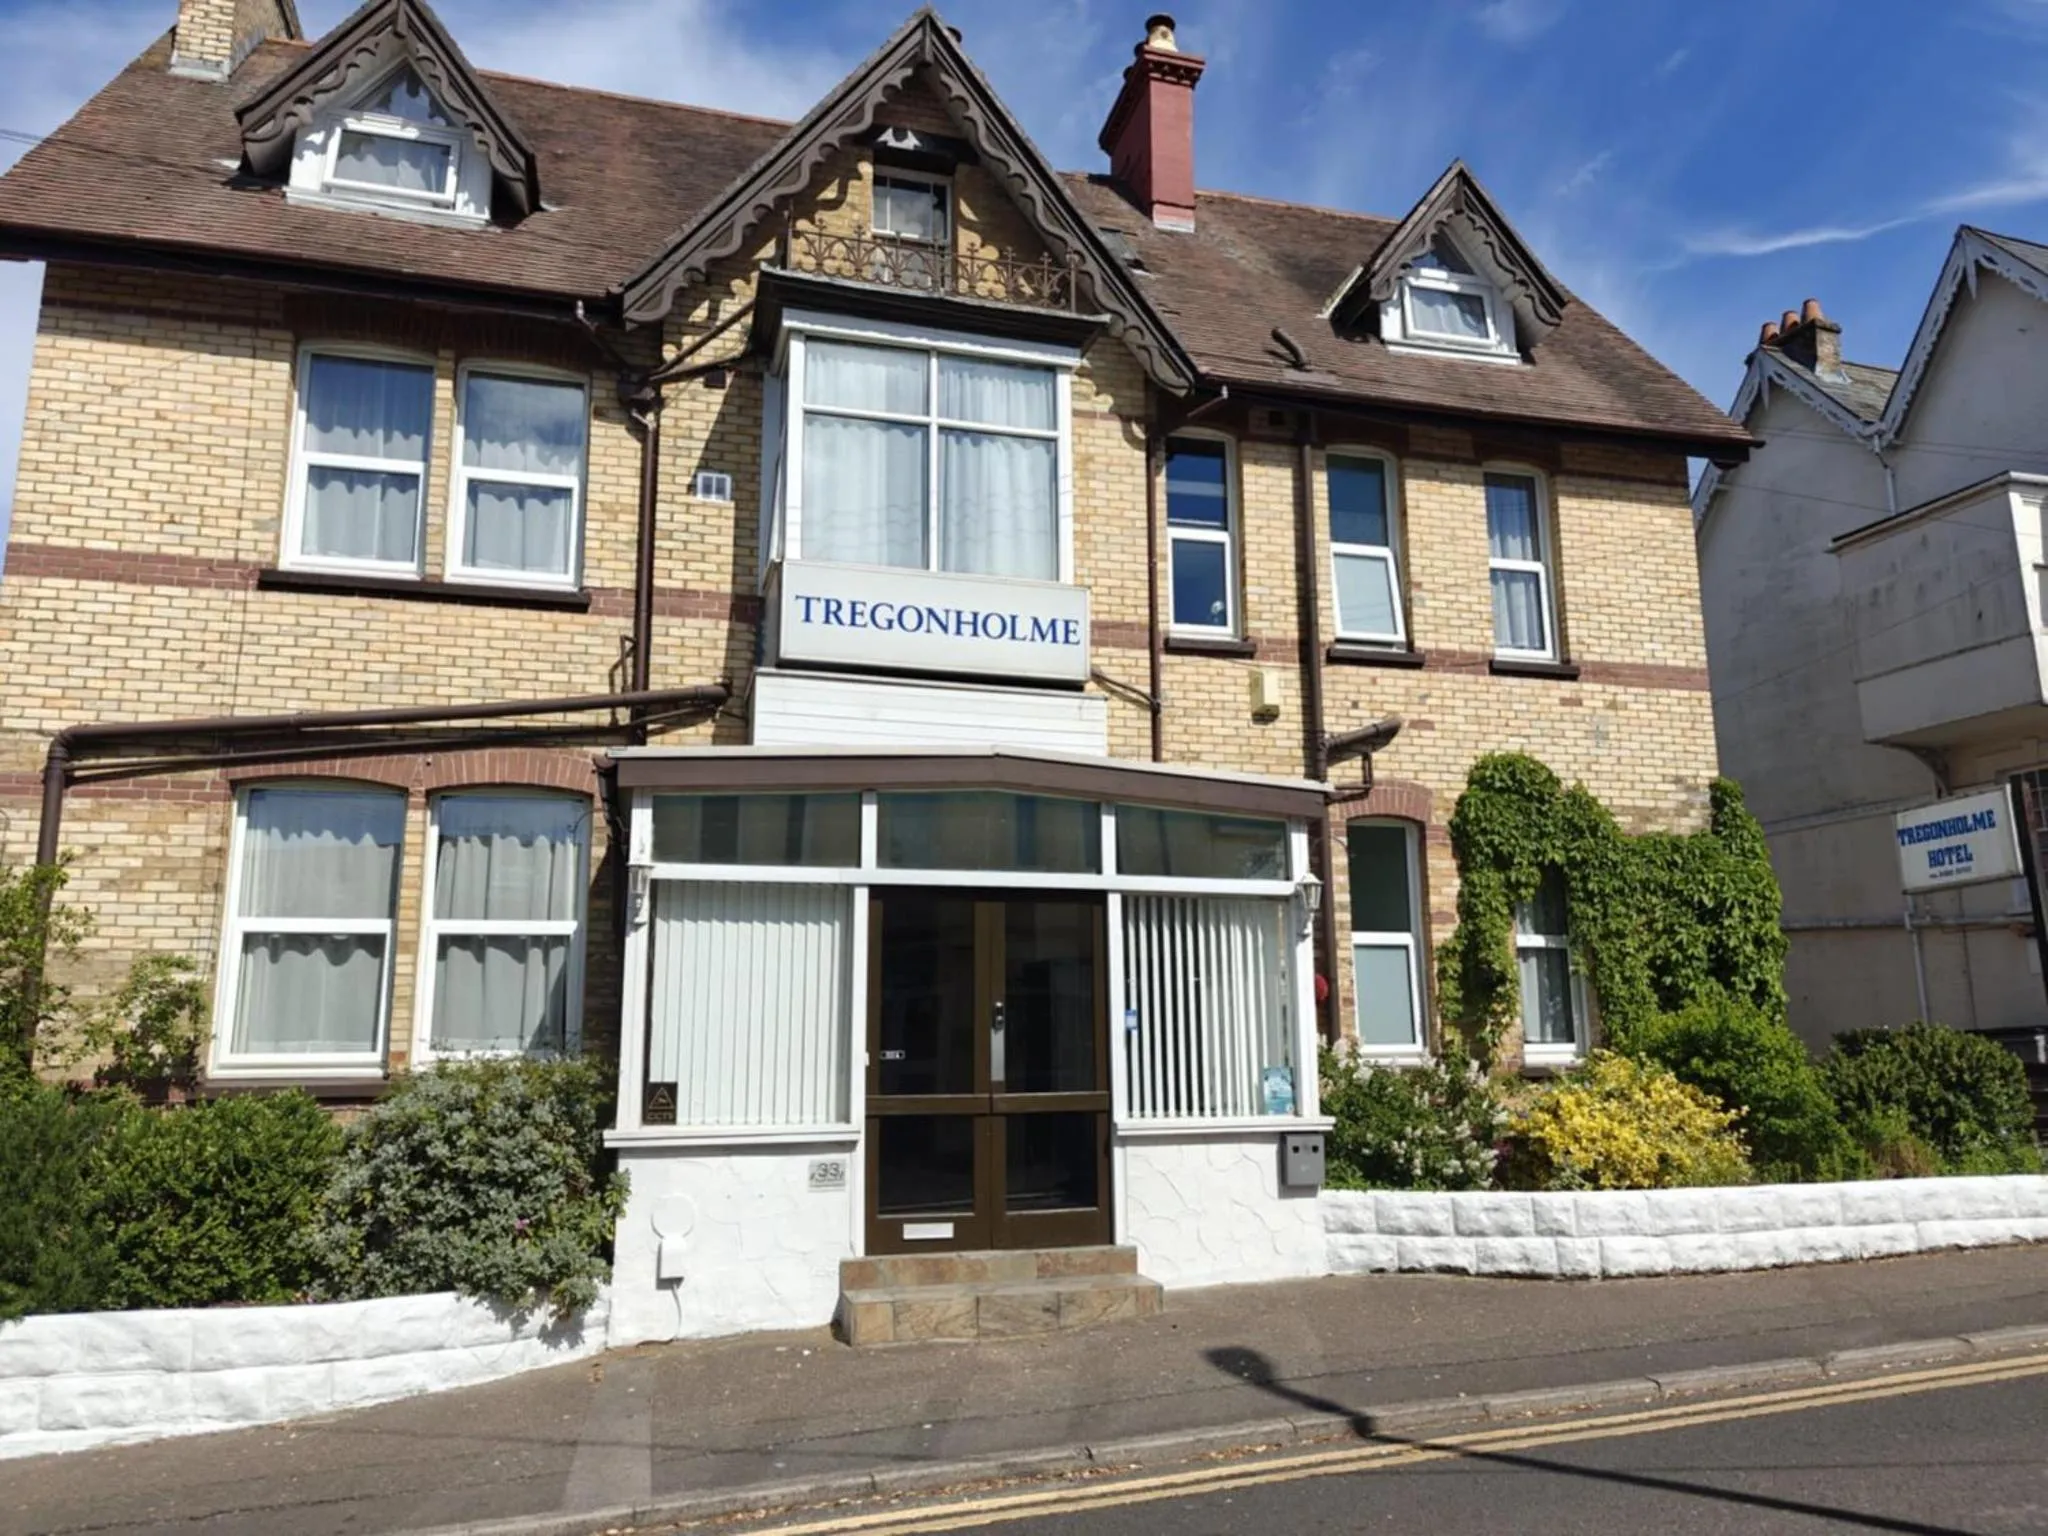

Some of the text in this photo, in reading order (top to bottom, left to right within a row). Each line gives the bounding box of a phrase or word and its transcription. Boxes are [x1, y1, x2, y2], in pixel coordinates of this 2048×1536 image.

[795, 595, 1080, 645] TREGONHOLME
[1897, 808, 1996, 846] TREGONHOLME
[1927, 843, 1973, 868] HOTEL
